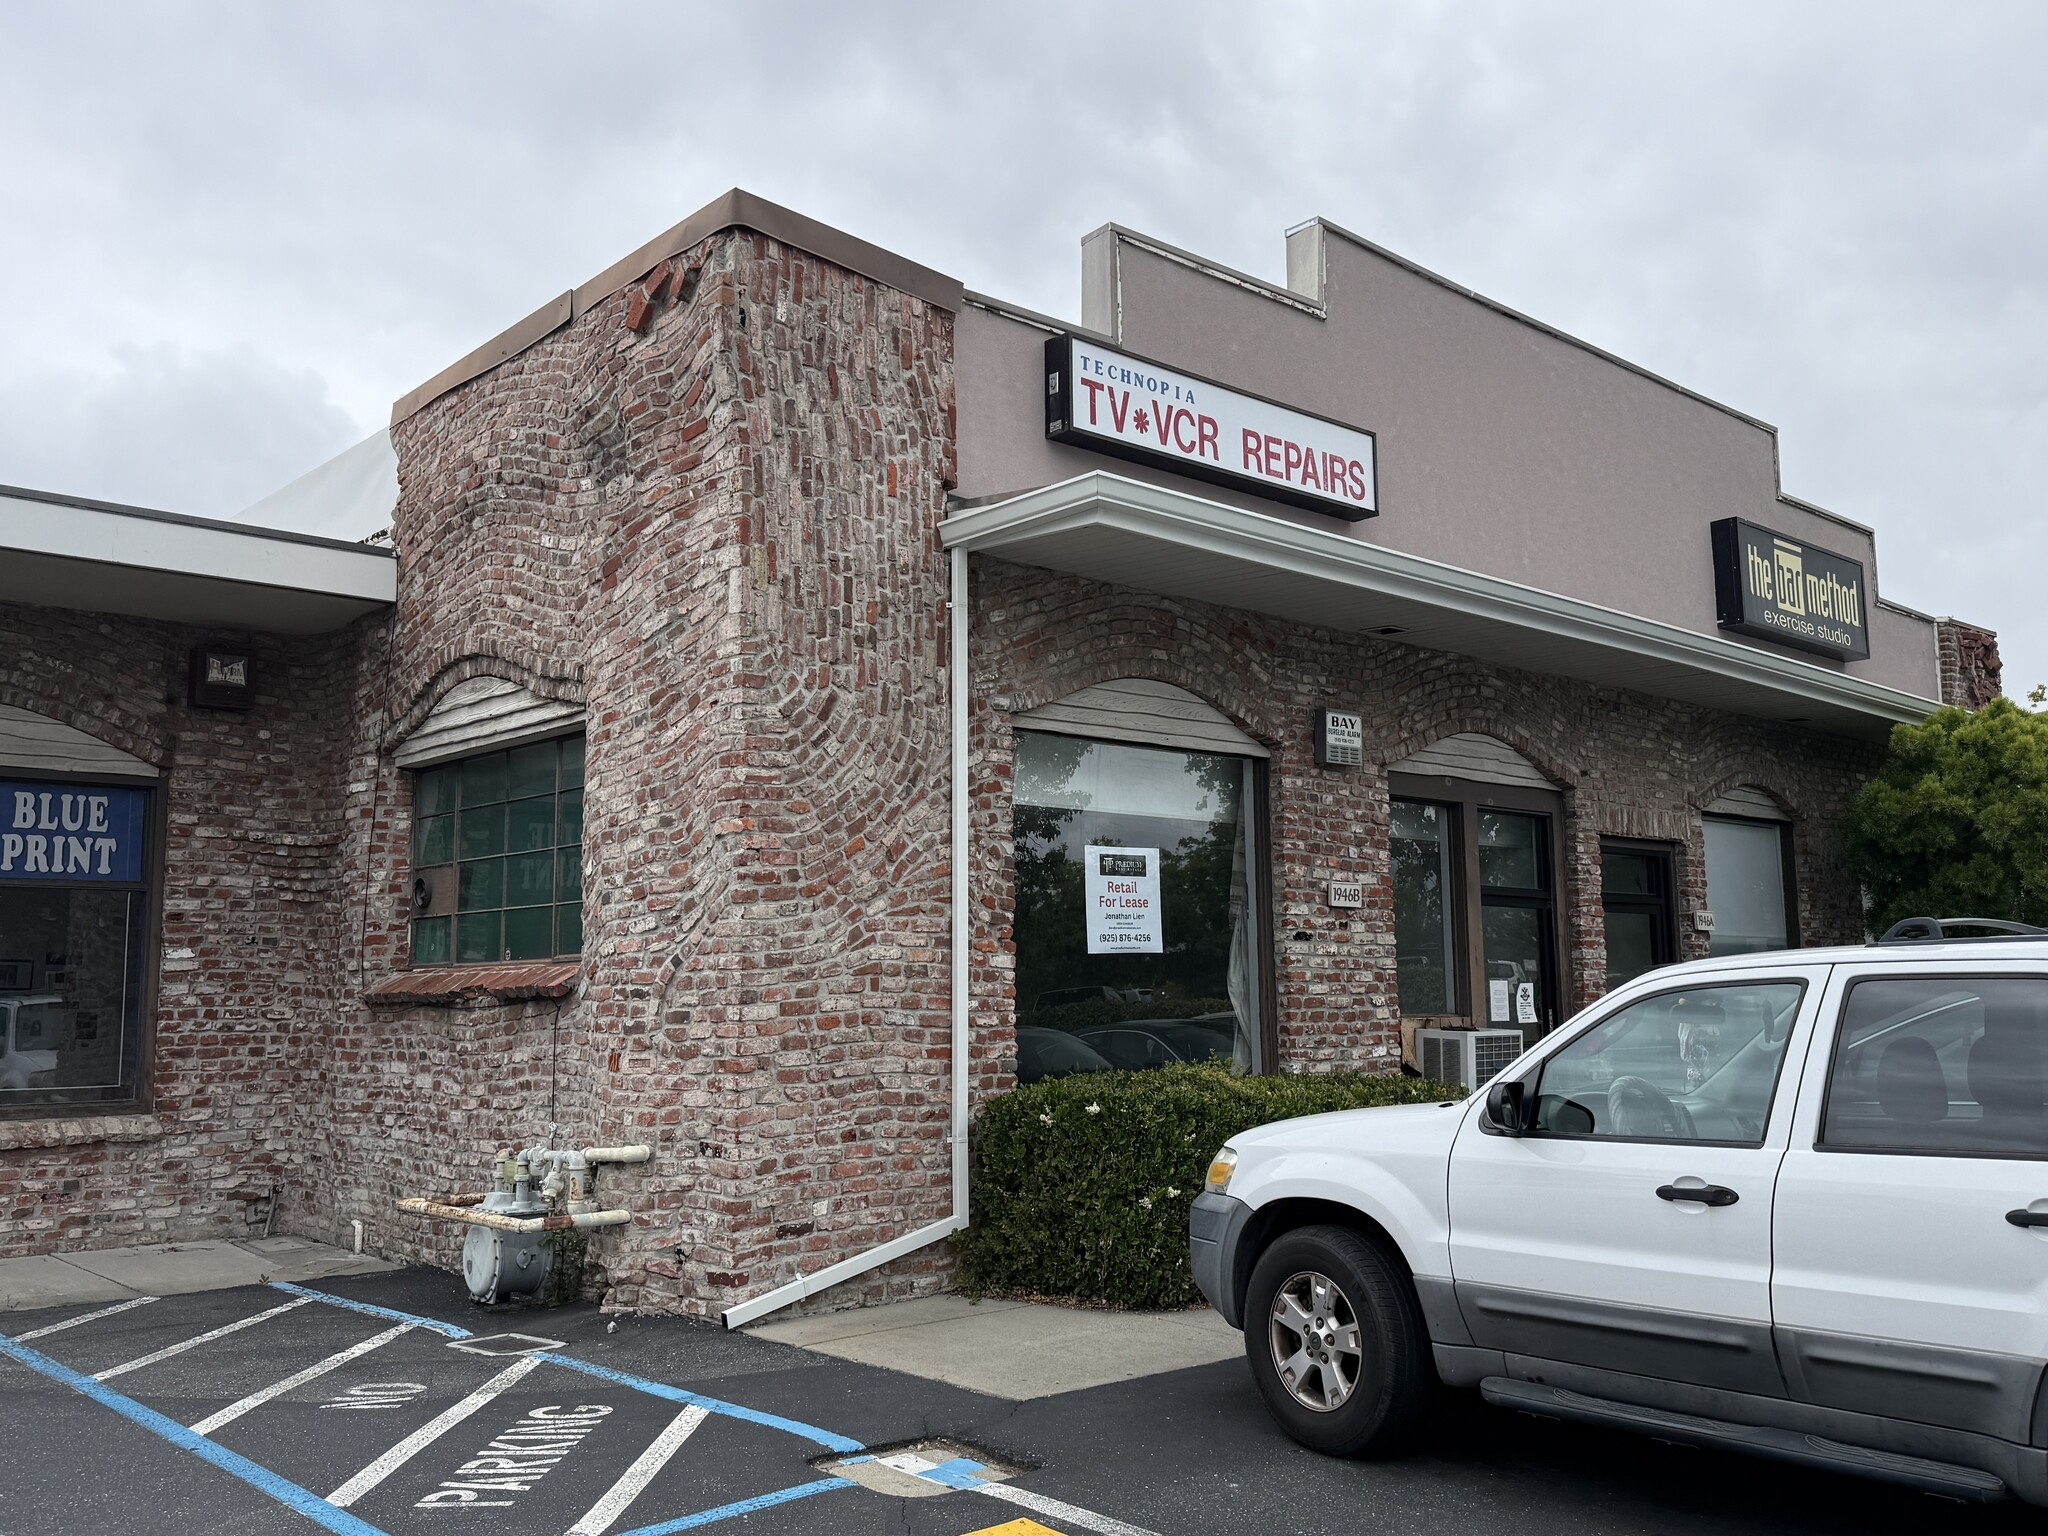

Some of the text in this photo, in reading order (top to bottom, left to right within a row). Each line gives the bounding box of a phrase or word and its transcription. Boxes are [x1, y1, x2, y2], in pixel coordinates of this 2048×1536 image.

[1080, 355, 1196, 404] TECHNOPIA
[1242, 428, 1366, 501] REPAIRS
[1747, 543, 1773, 600] the
[1775, 551, 1803, 611] bar
[1764, 609, 1851, 646] exercise studio
[1331, 716, 1357, 730] BAY
[12, 791, 109, 833] BLUE
[0, 833, 117, 875] PRINT
[1099, 895, 1149, 908] For Lease
[1107, 881, 1138, 894] Retail
[1333, 887, 1360, 902] 1946B
[1104, 912, 1132, 920] Jonathan
[1099, 933, 1118, 943] (925)
[317, 1382, 428, 1409] NO
[413, 1404, 614, 1509] PARKING
